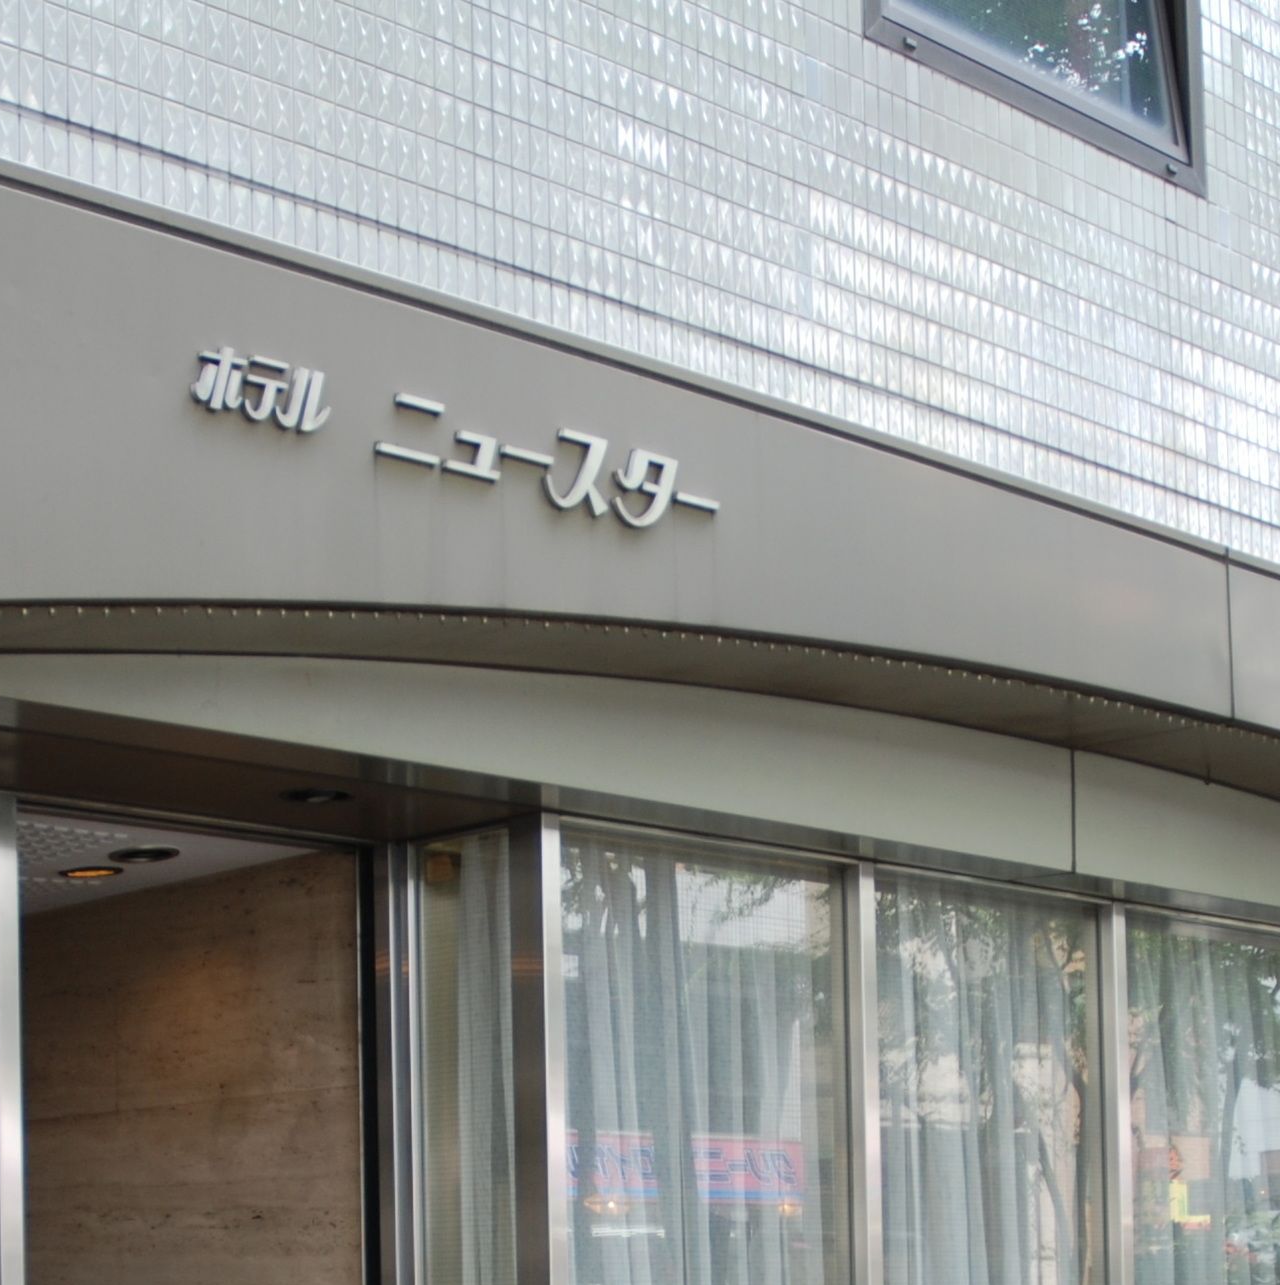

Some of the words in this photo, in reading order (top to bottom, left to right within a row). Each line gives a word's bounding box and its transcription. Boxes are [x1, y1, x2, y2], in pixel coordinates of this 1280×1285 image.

[190, 346, 331, 433] ホテル
[374, 392, 720, 527] ニュースター
